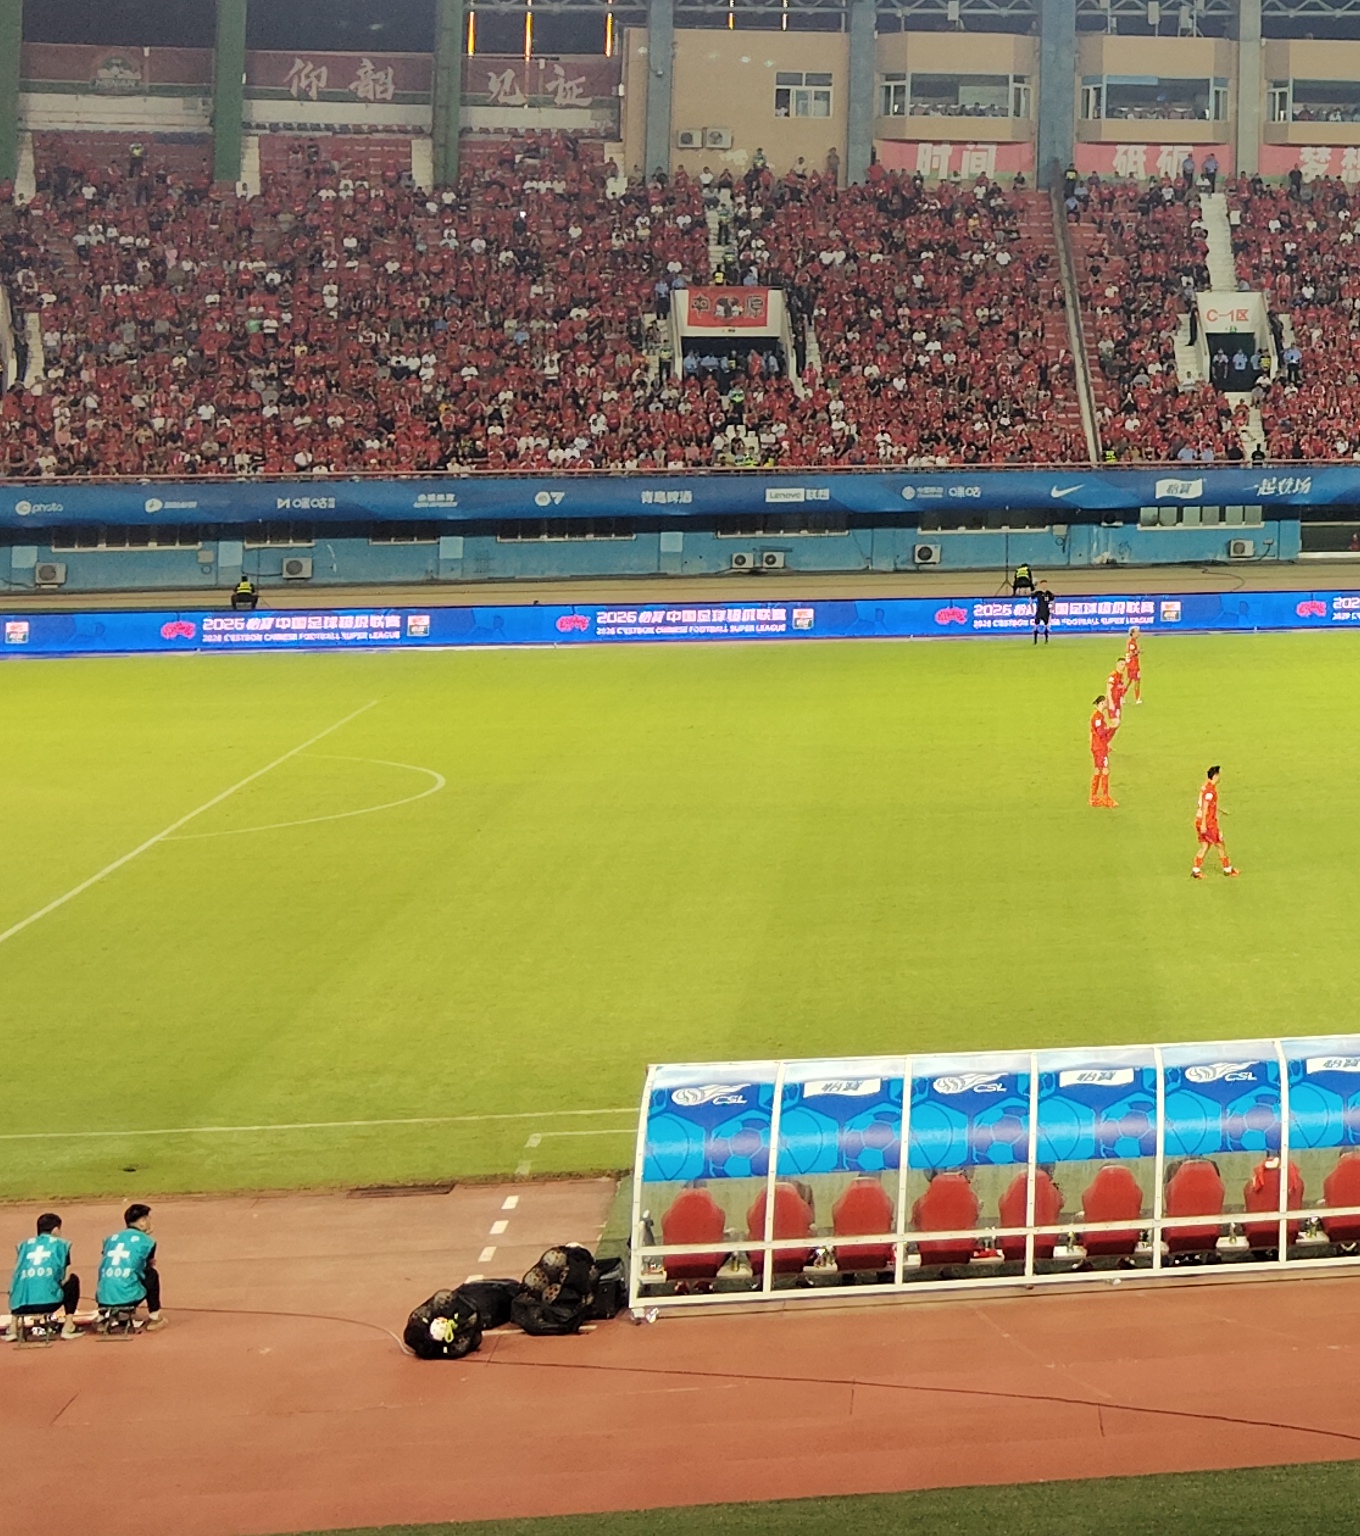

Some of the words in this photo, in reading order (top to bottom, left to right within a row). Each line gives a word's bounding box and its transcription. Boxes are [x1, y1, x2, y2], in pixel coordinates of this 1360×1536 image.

[284, 57, 397, 101] 仰韶
[916, 144, 997, 180] 时间
[1112, 144, 1193, 180] 砥砺
[1206, 309, 1249, 322] C-1区
[769, 492, 801, 500] Lenovo
[1049, 601, 1154, 614] 国足球超级联赛
[1225, 1071, 1257, 1081] CSL
[973, 1083, 1007, 1093] CSL
[712, 1095, 747, 1105] CSL
